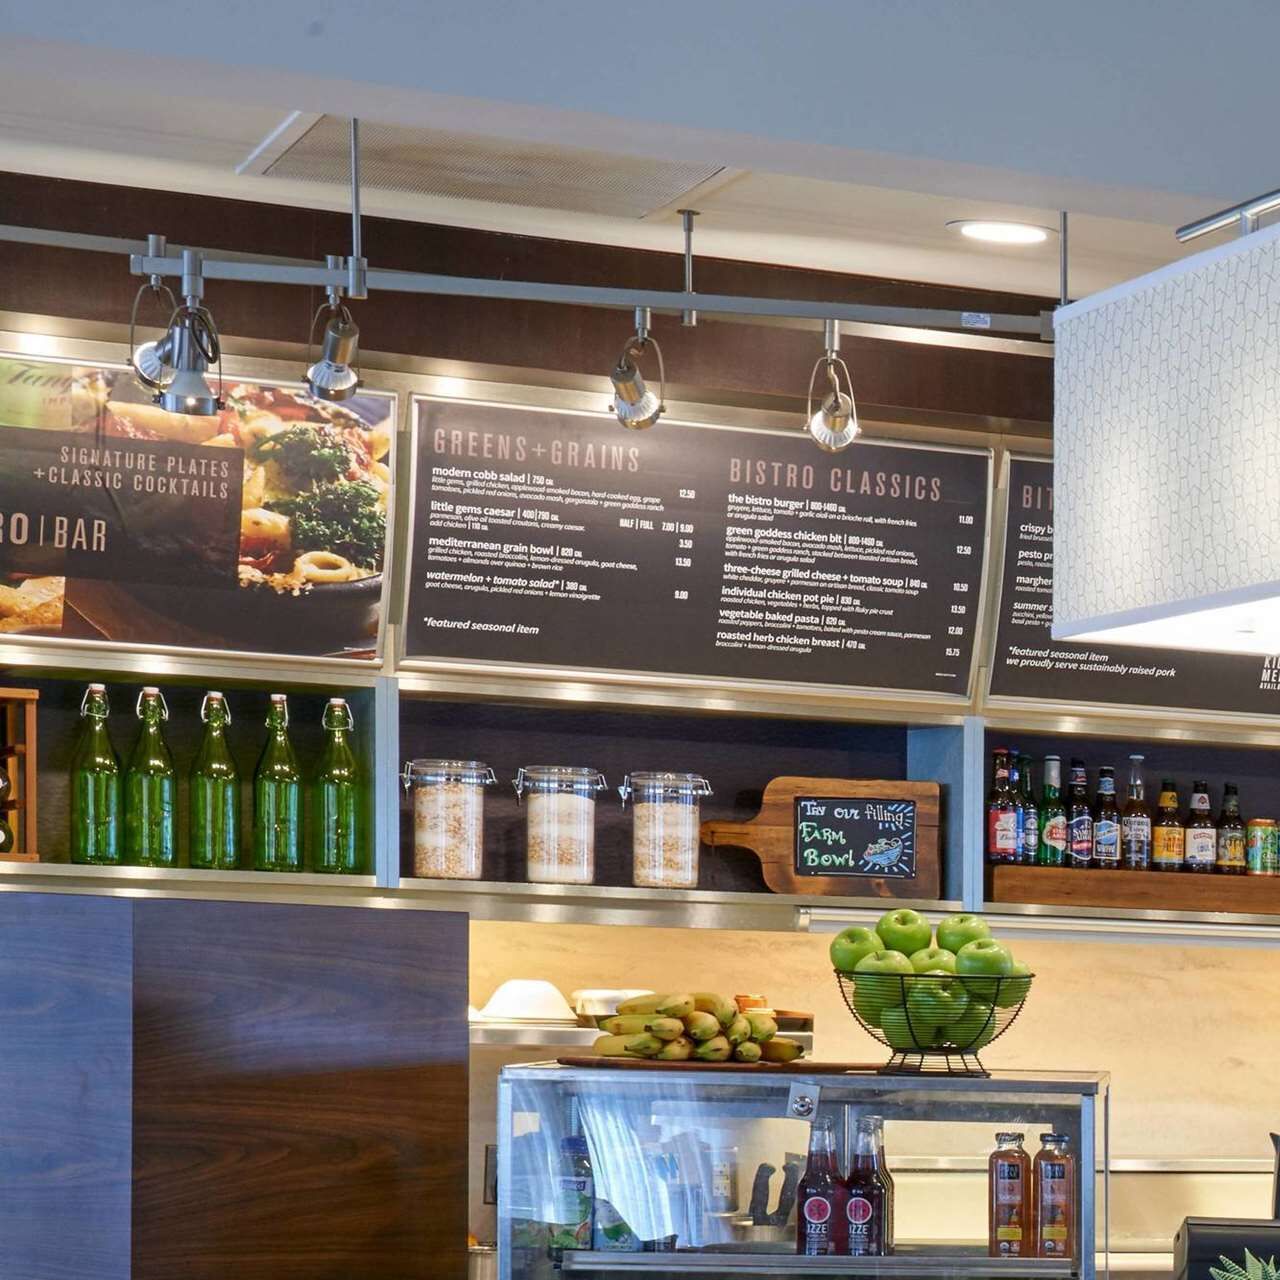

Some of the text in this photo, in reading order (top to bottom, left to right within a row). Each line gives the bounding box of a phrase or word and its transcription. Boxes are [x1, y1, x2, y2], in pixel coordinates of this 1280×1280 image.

[433, 427, 639, 472] GREENS+GRAINS
[60, 446, 229, 478] SIGNATURE PLATES
[432, 465, 471, 477] modern
[473, 468, 497, 480] cobb
[499, 471, 524, 482] salad
[729, 457, 941, 501] BISTRO CLASSICS
[33, 466, 229, 500] +CLASSIC COCKTAILS
[728, 493, 804, 511] the bistro burger
[1022, 485, 1053, 511] BIT
[430, 500, 515, 516] little gems caesar
[54, 516, 107, 552] BAR
[726, 526, 841, 542] green goddess chicken blt
[1020, 523, 1045, 535] crispy
[428, 535, 501, 550] mediterranean
[503, 542, 527, 554] grain
[529, 544, 553, 554] bowl
[1018, 550, 1042, 560] pesto
[427, 569, 483, 582] watermelon
[493, 575, 527, 586] tomato
[723, 562, 781, 576] three-cheese
[782, 567, 810, 580] grilled
[811, 570, 841, 581] cheese
[849, 575, 881, 584] tomato
[882, 578, 903, 589] soup
[1016, 575, 1053, 588] margher
[721, 585, 766, 597] individual
[767, 589, 801, 600] chicken
[803, 592, 818, 603] pot
[820, 593, 834, 605] pie
[1013, 601, 1048, 612] summer
[719, 607, 763, 621] vegetable
[765, 611, 792, 621] baked
[794, 614, 819, 625] pasta
[471, 620, 515, 632] seasonal
[516, 623, 539, 634] item
[717, 629, 751, 640] roasted
[753, 632, 774, 642] herb
[775, 634, 809, 645] chicken
[811, 636, 840, 647] breast
[1050, 649, 1087, 660] seasonal
[1088, 652, 1108, 661] item
[1019, 657, 1053, 669] proudly
[1078, 661, 1127, 674] sustainably
[1128, 665, 1154, 675] raised
[1155, 667, 1176, 677] pork
[865, 804, 904, 829] filling
[806, 1224, 828, 1234] IZZE
[849, 1224, 869, 1234] IZZE
